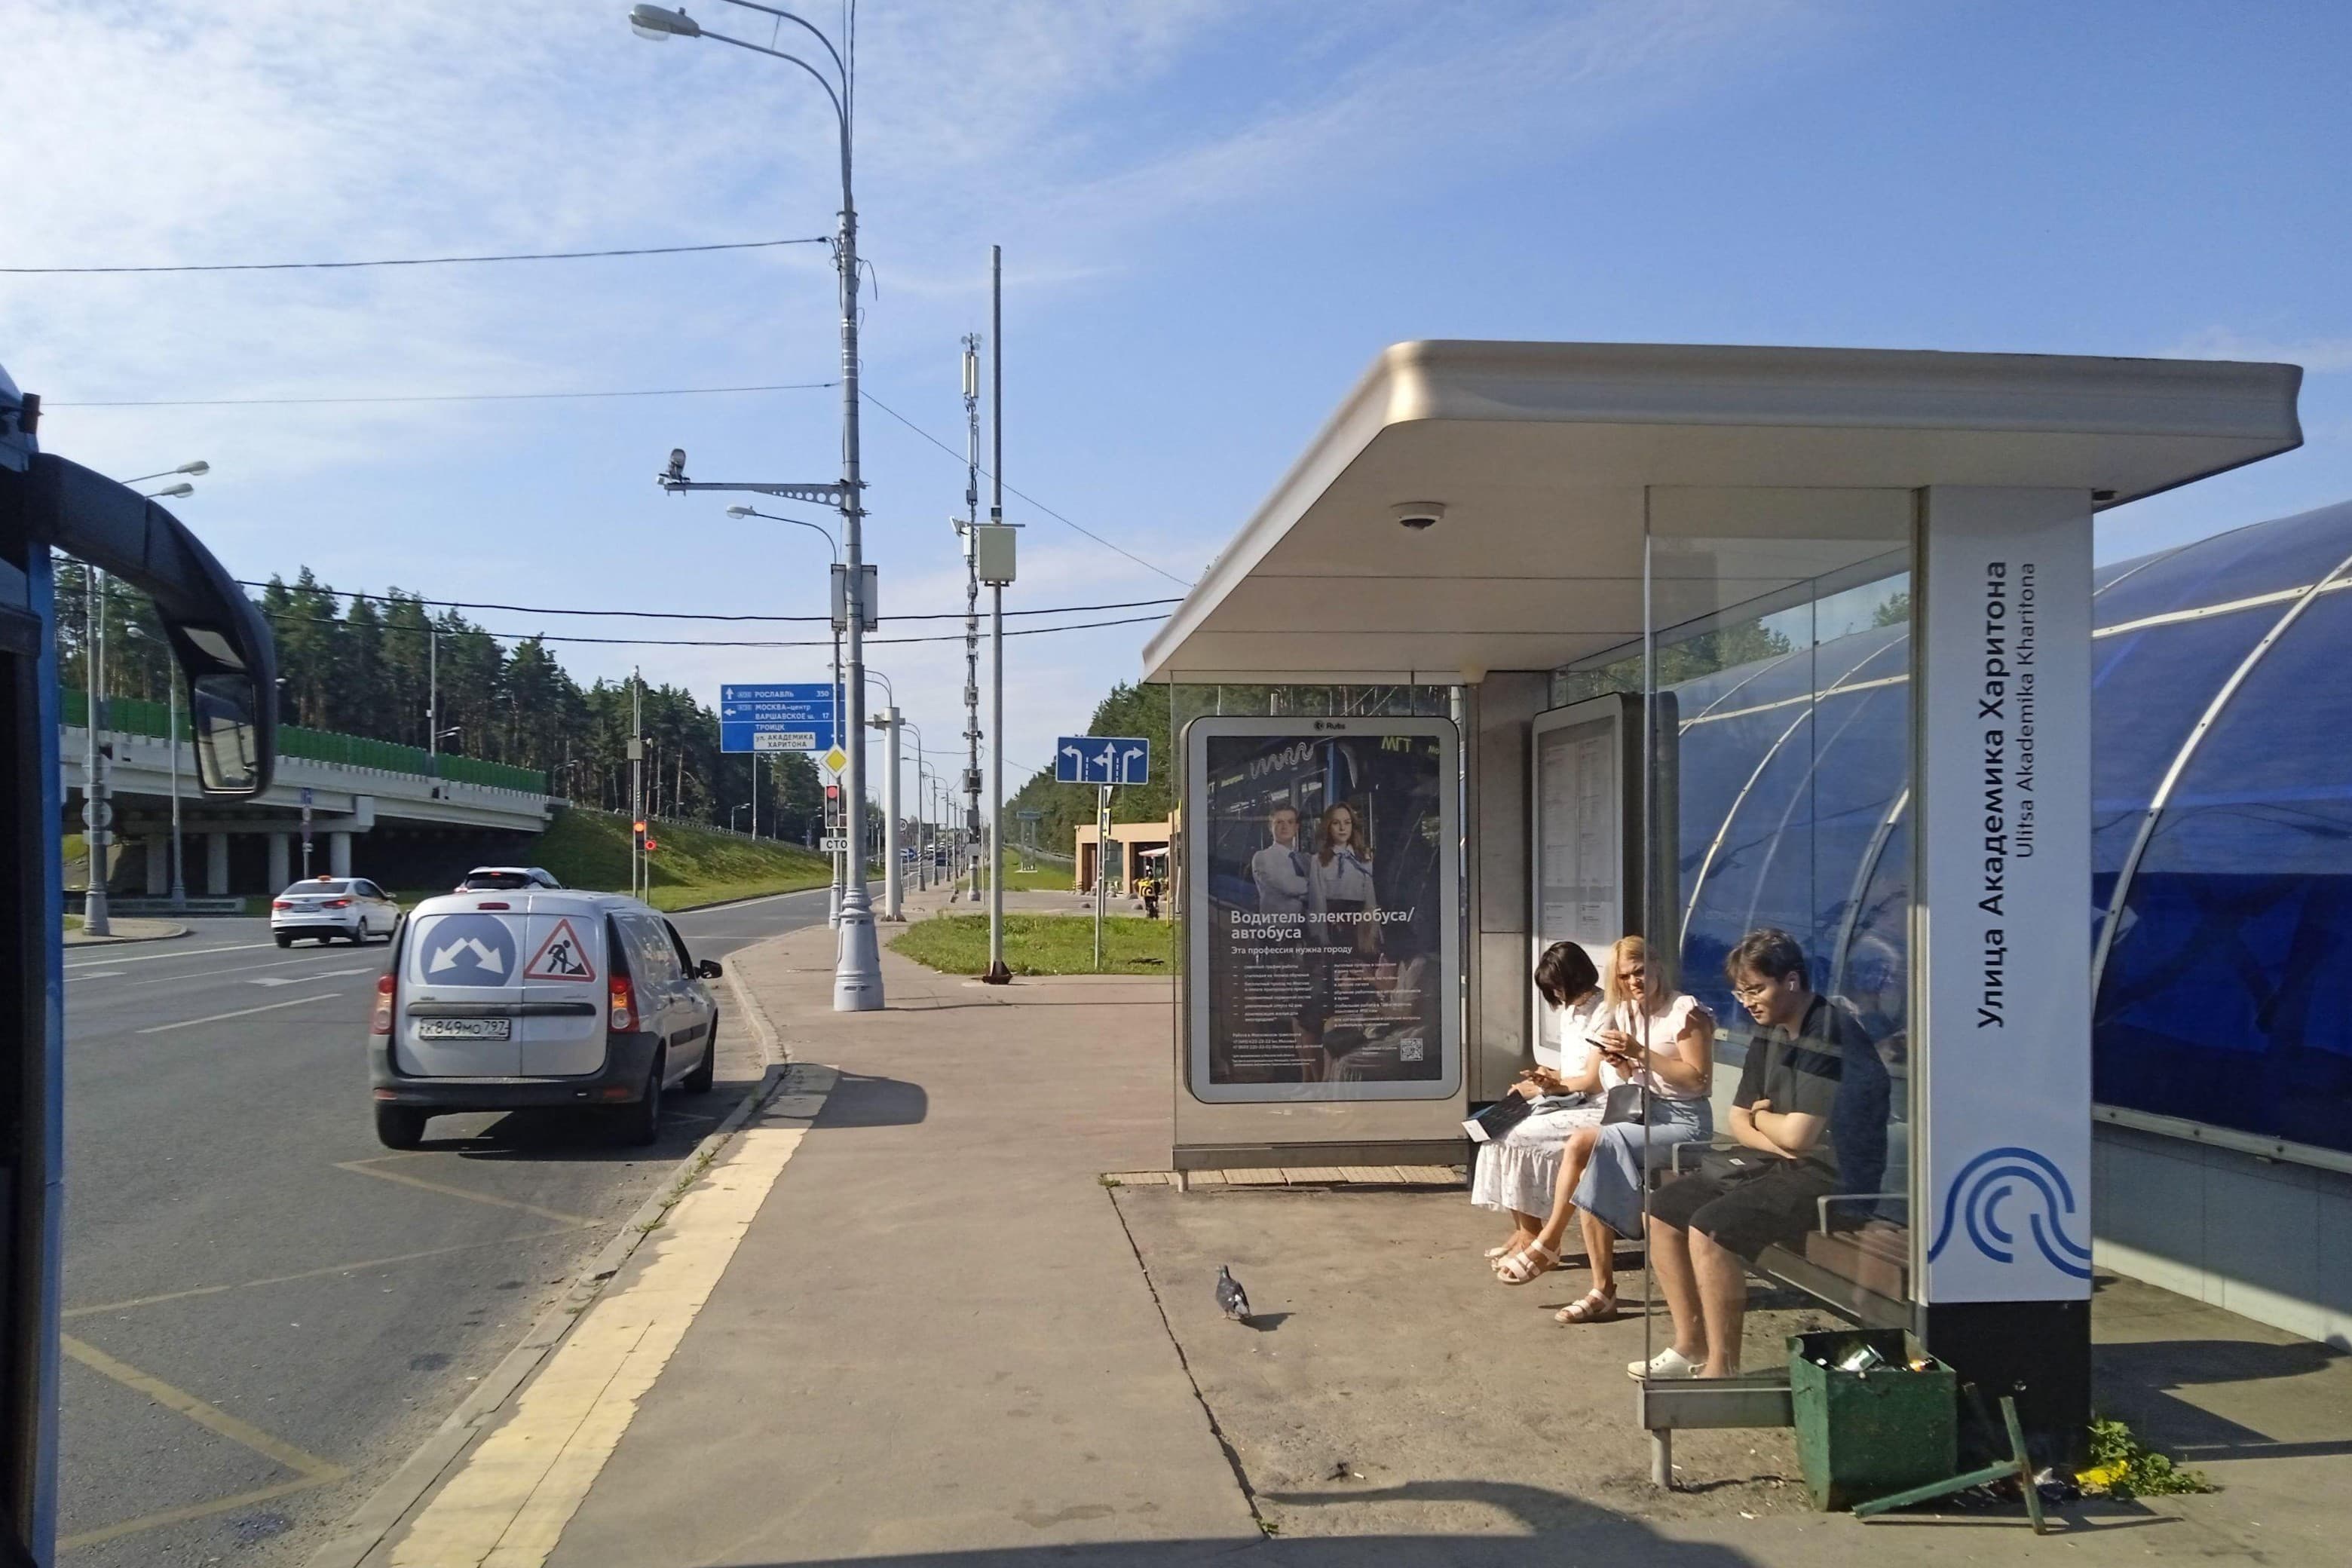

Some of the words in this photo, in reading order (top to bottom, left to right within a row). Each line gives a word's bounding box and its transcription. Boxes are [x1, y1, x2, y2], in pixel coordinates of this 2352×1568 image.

[1977, 560, 2011, 721] Харитона
[2016, 562, 2035, 666] Kharitona
[2016, 674, 2035, 791] Akademika
[826, 840, 847, 849] СТО
[1977, 727, 2007, 917] Академика
[2016, 796, 2035, 858] Ulitsa
[1231, 910, 1306, 925] Водитель
[1309, 907, 1415, 926] электробуса/
[1231, 926, 1301, 941] автобуса
[1248, 946, 1294, 956] профессия
[1295, 947, 1321, 955] нужна
[1324, 946, 1352, 955] городу
[1977, 926, 2007, 1030] Улица
